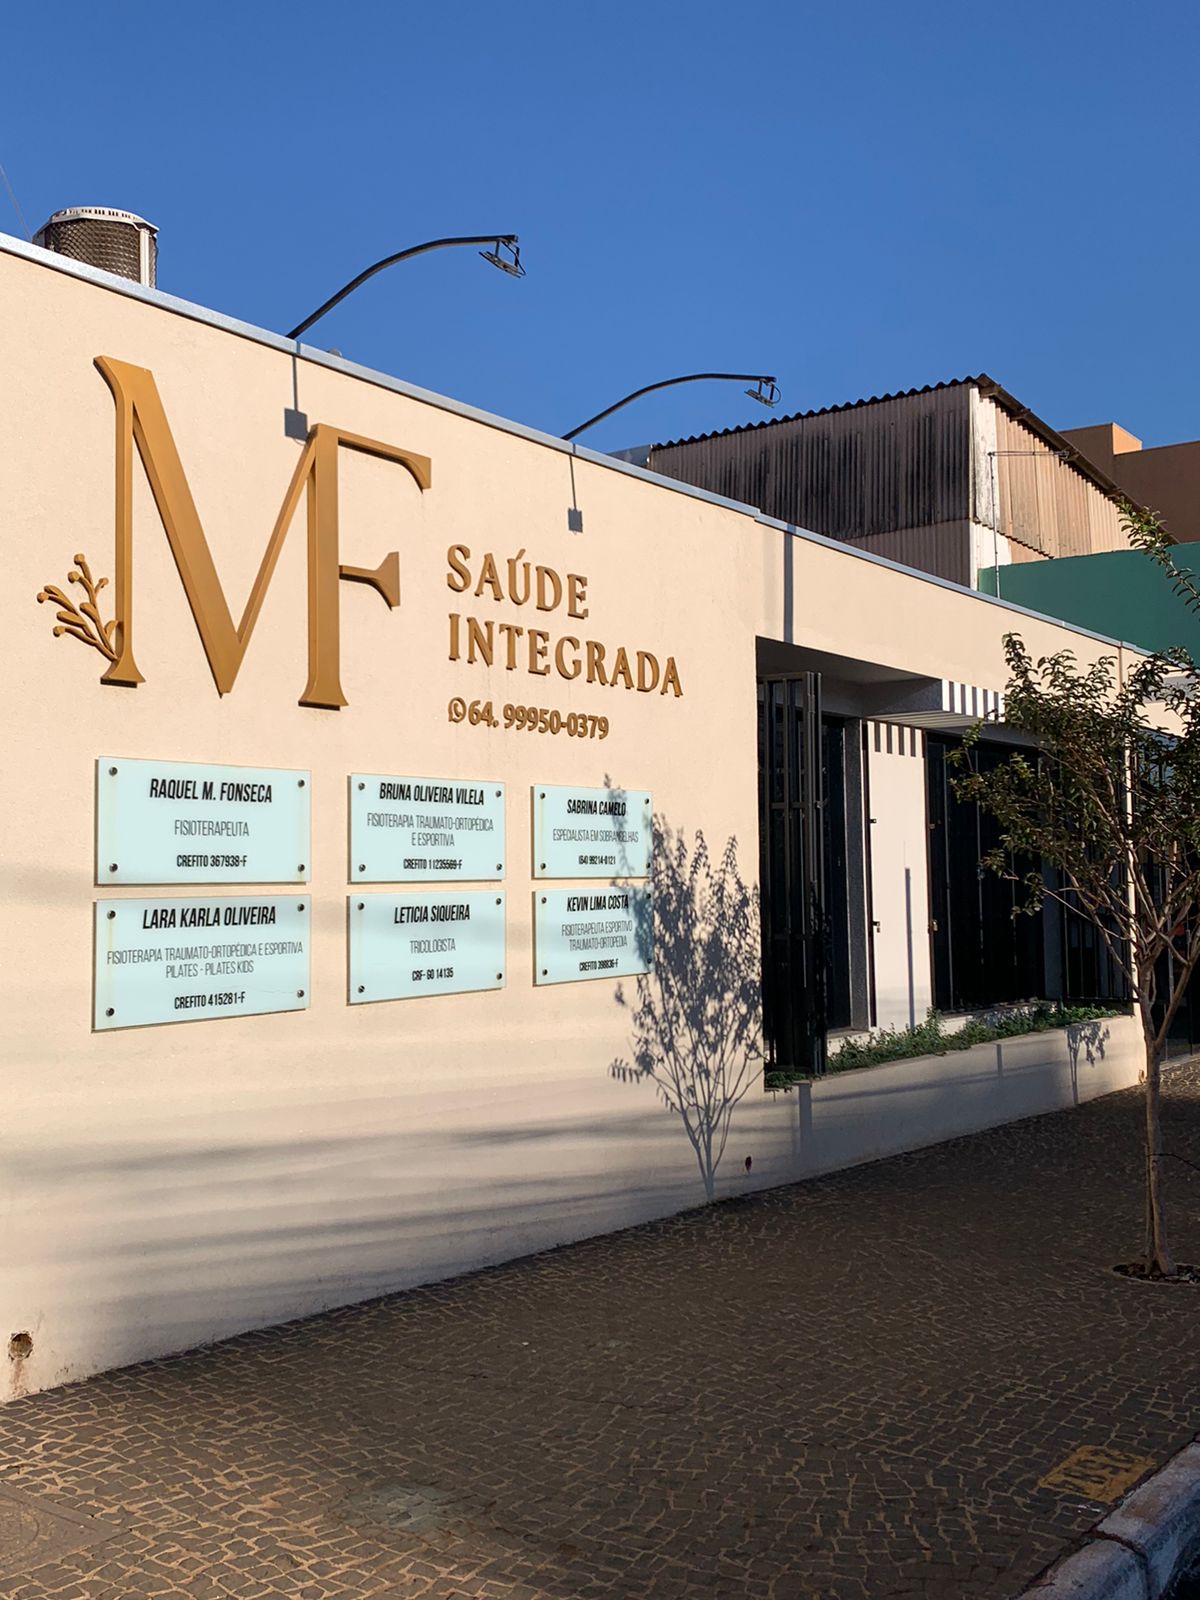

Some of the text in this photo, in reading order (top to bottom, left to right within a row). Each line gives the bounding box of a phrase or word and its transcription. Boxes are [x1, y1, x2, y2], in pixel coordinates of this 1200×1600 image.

[447, 544, 589, 619] SAÚDE
[448, 613, 683, 698] INTEGRADA
[468, 700, 609, 740] 64. 99950-0379
[149, 778, 272, 803] RAQUEL M. FONSECA
[379, 782, 485, 805] BRUNA OLIVEIRA VILELA
[567, 799, 626, 816] SABRINA CAMELO
[174, 819, 249, 837] FISIOTERAPEUTA
[367, 812, 494, 832] FISIOTERAPIA TRAUMATO-ORTOPÉDICA
[412, 832, 454, 847] E ESPORTIVA
[553, 829, 589, 842] ESPECIALISTA
[590, 830, 599, 842] EM
[177, 855, 247, 867] CREFITO 367938-F
[403, 858, 427, 869] CREFITO
[567, 894, 629, 912] KEVIN LIMA COSTA
[142, 906, 276, 929] LARA KARLA OLIVEIRA
[394, 904, 470, 924] LETICIA SIQUEIRA
[562, 919, 633, 936] FISIOTERAPEUTA ESPORTIVO
[107, 941, 303, 965] FISIOTERAPIA TRAUMATO-ORTOPÉDICA E ESPORTIVA
[410, 938, 456, 954] TRICOLOGISTA
[165, 964, 199, 979] PILATES
[205, 961, 236, 976] PILATES
[237, 960, 254, 974] KIDS
[412, 969, 425, 981] CRF-
[436, 967, 453, 979] 14135
[579, 962, 597, 972] CREFITO
[174, 991, 245, 1010] CREFITO 415281-F
